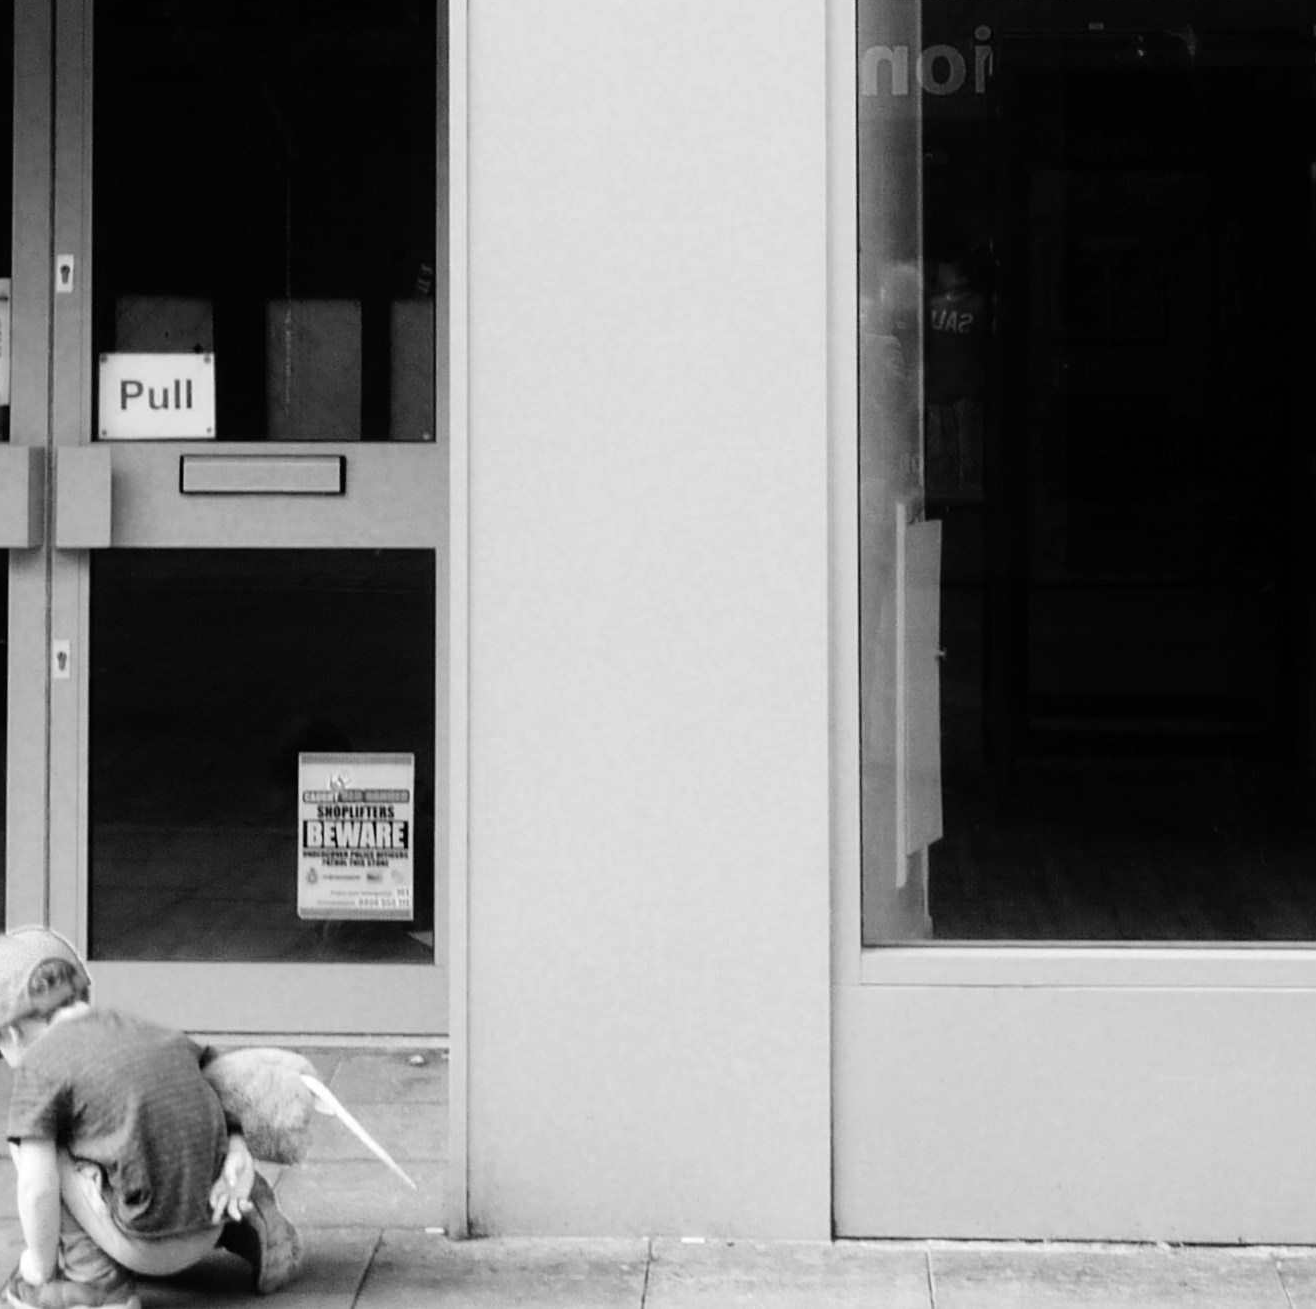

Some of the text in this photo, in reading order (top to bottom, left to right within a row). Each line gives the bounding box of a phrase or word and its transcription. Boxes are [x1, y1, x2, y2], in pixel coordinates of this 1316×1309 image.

[120, 378, 193, 410] Pull
[317, 805, 395, 819] SHOPLIFTERS
[306, 821, 405, 848] BEWARE
